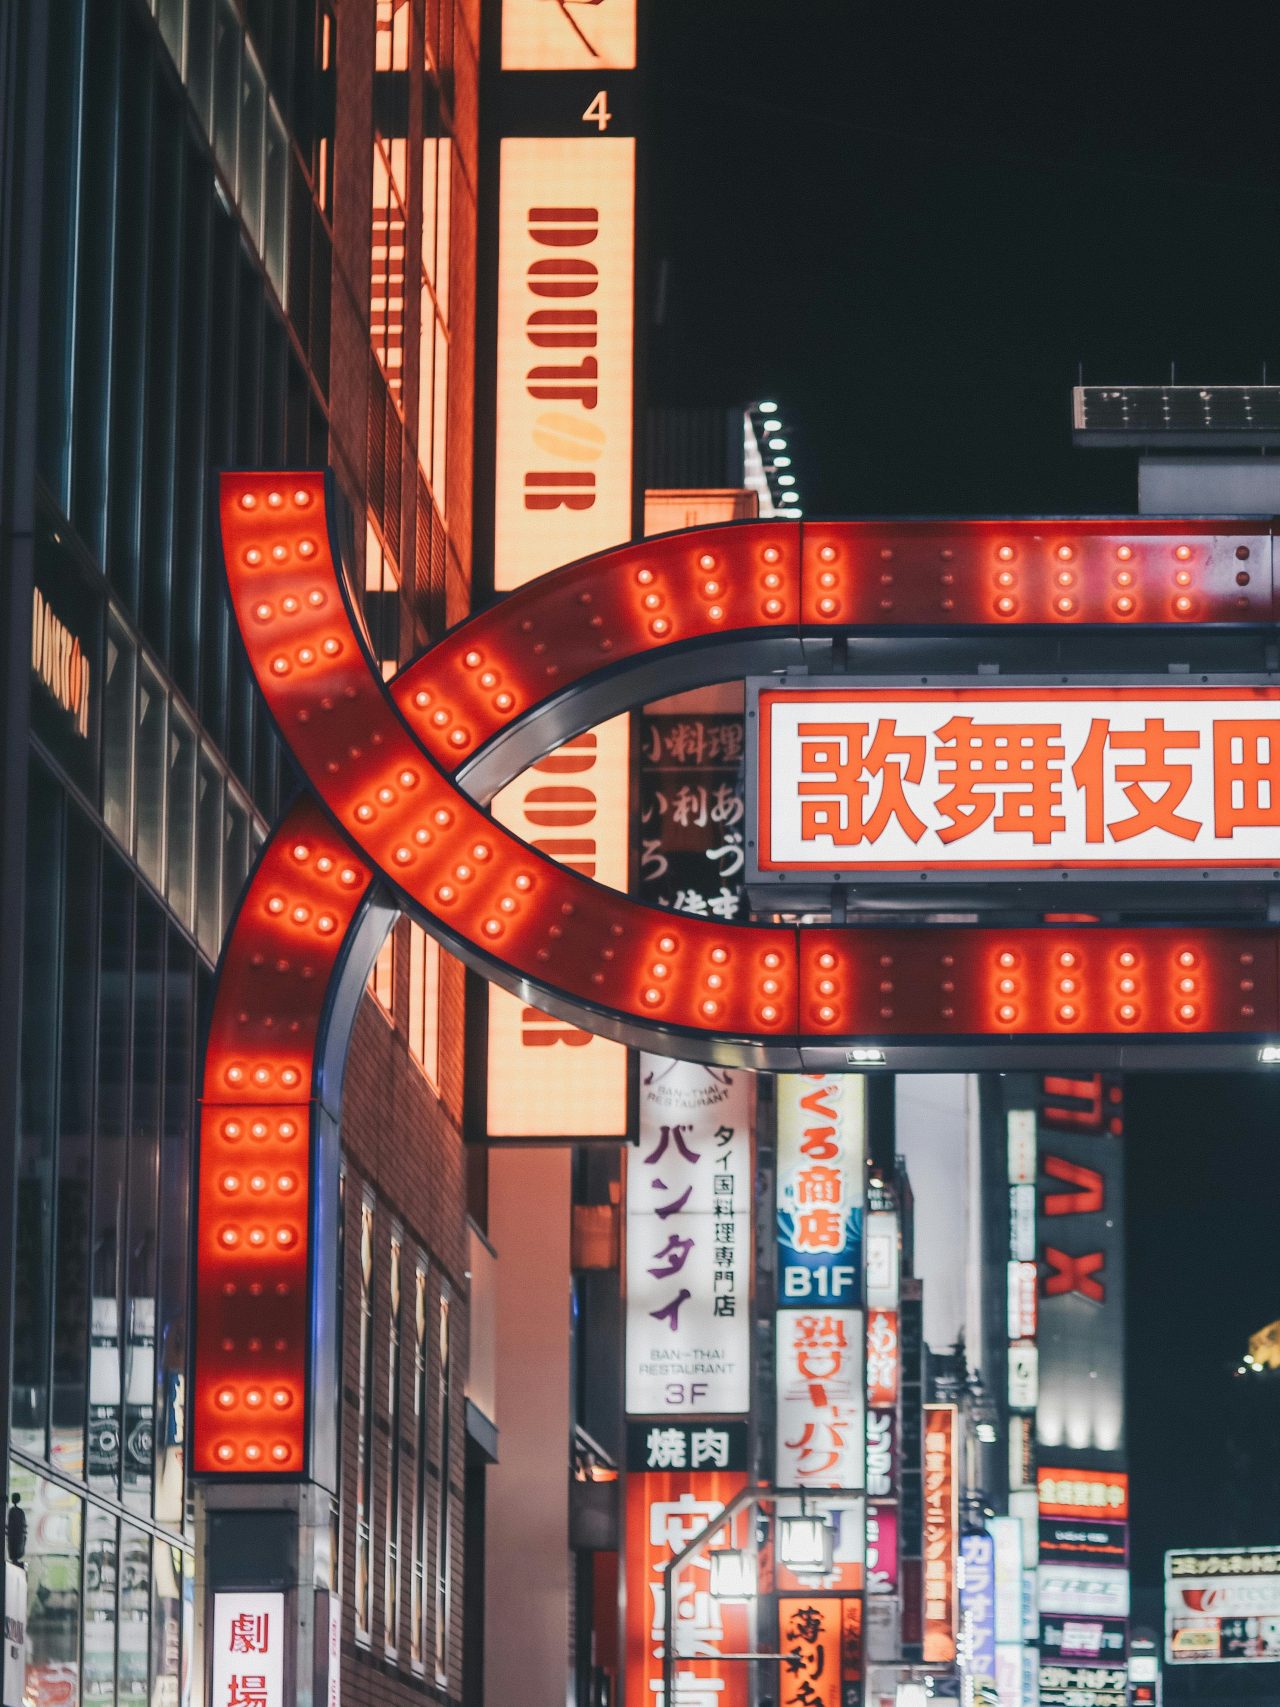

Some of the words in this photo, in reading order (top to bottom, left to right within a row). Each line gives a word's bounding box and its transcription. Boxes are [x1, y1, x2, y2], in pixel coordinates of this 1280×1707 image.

[581, 91, 611, 131] 4
[523, 207, 606, 511] DOUTOR
[799, 1073, 842, 1249] ぐろ商店
[643, 1125, 700, 1332] バンタイ
[712, 1125, 736, 1318] タイ国料理専門店
[784, 1266, 854, 1298] B1F
[639, 1363, 736, 1377] RESTAURANT
[665, 1383, 709, 1405] 3F
[647, 1427, 730, 1469] 焼肉
[226, 1612, 270, 1707] 劇場
